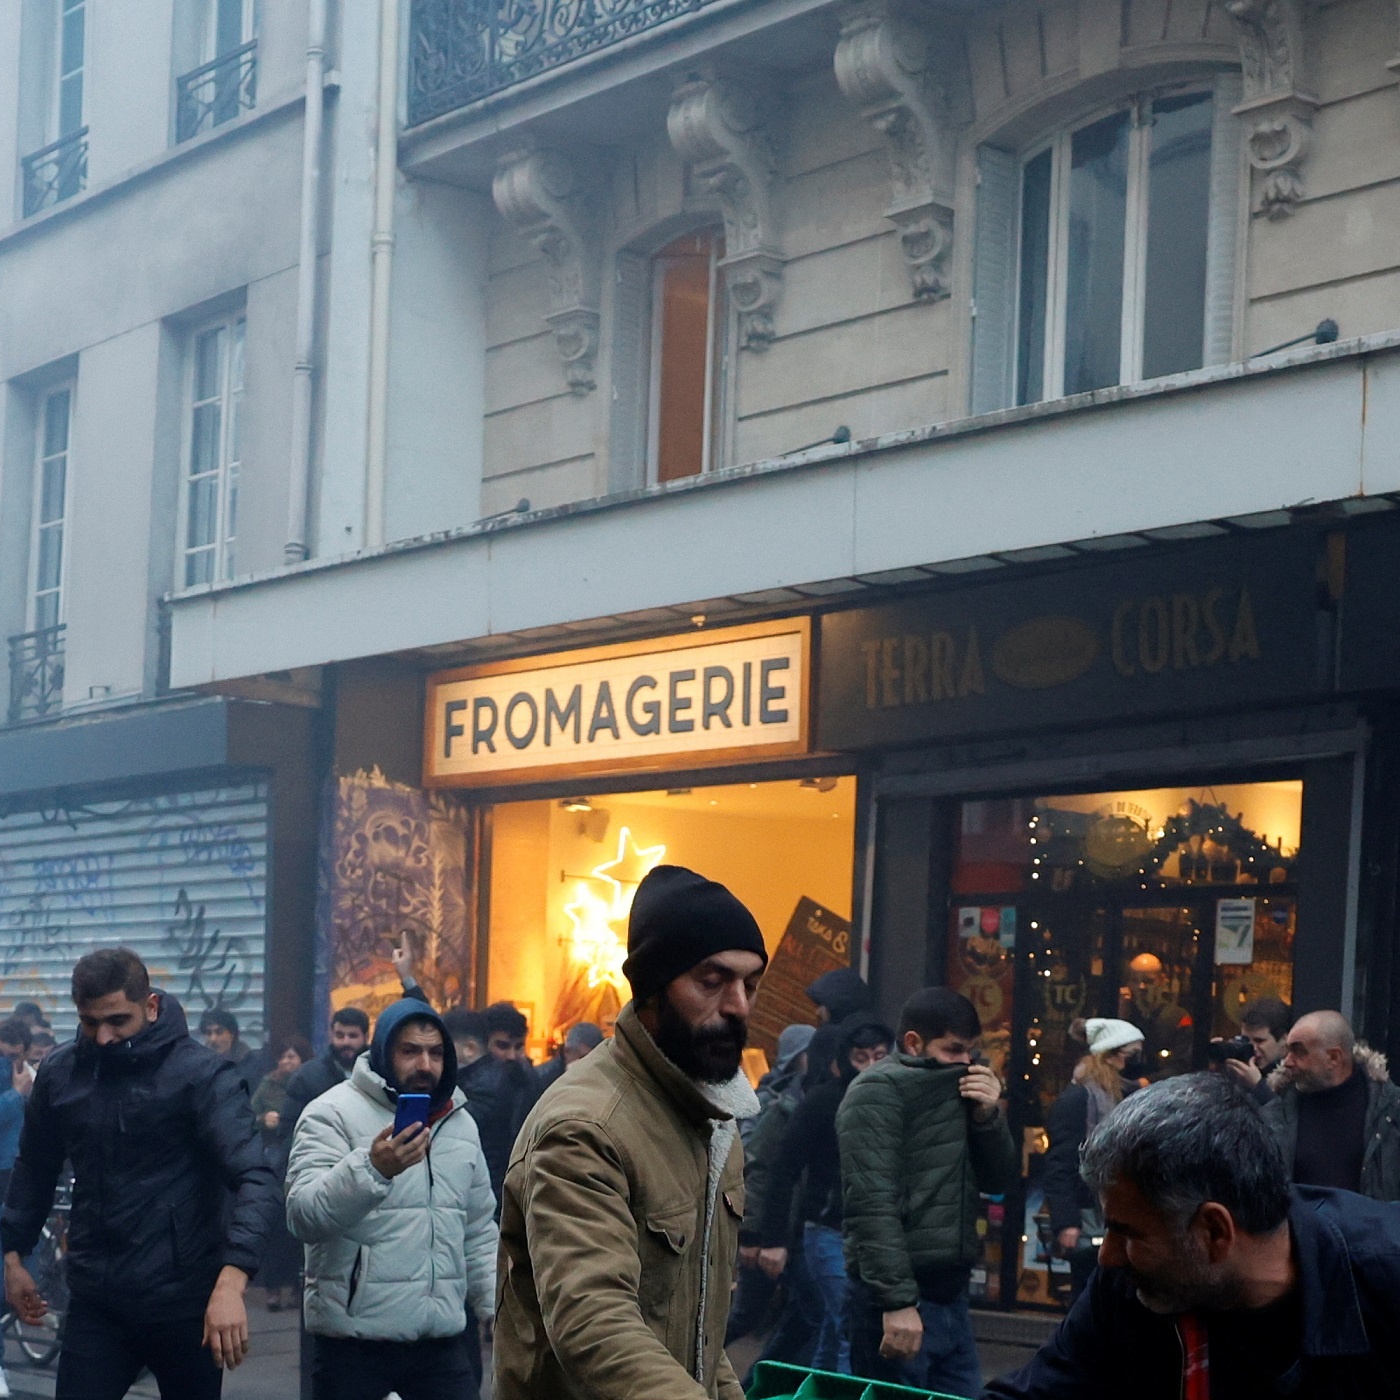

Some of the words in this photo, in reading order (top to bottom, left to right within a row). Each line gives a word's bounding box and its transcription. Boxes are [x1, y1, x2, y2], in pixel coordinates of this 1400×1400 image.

[860, 627, 986, 711] TERRA
[1110, 587, 1262, 677] CORSA
[442, 655, 792, 758] FROMAGERIE
[1054, 982, 1077, 1004] TC
